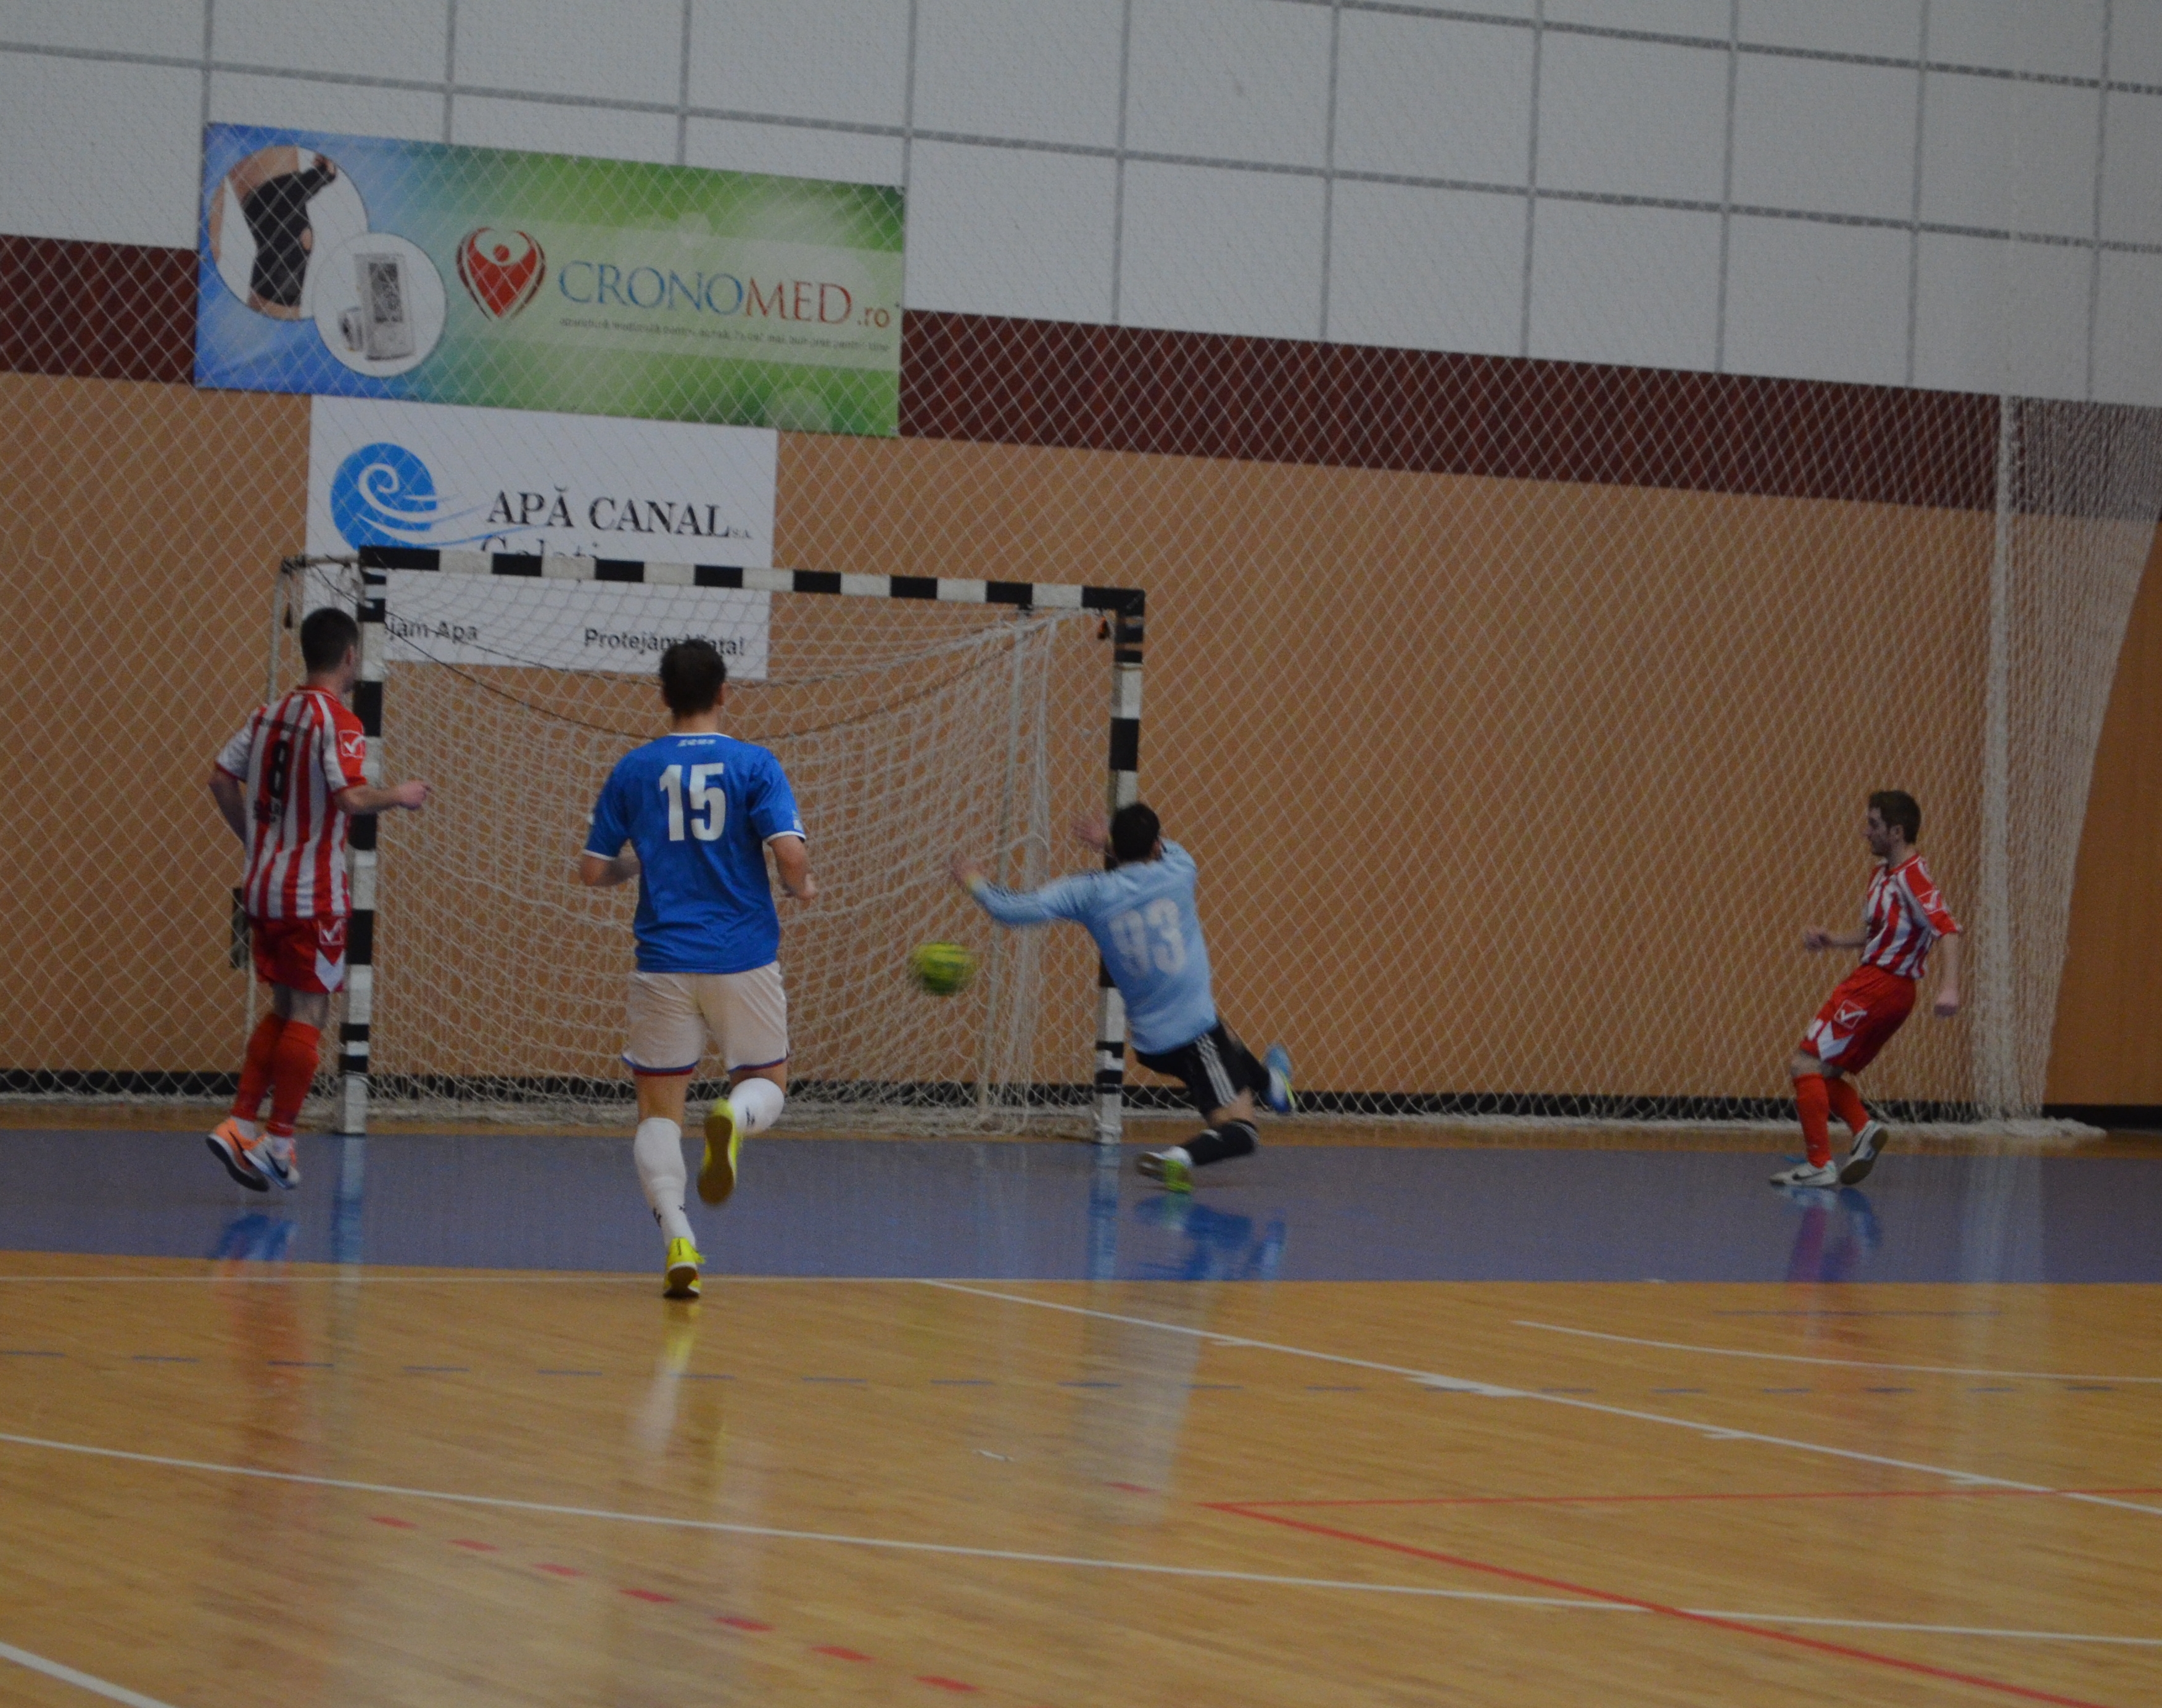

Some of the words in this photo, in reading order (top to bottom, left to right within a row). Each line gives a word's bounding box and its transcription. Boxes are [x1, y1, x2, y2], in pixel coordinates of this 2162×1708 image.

[559, 260, 890, 328] CRONOMED.ro
[487, 484, 574, 527] APĂ
[588, 496, 730, 538] CANAL
[269, 740, 289, 798] 8
[659, 762, 727, 841] 15
